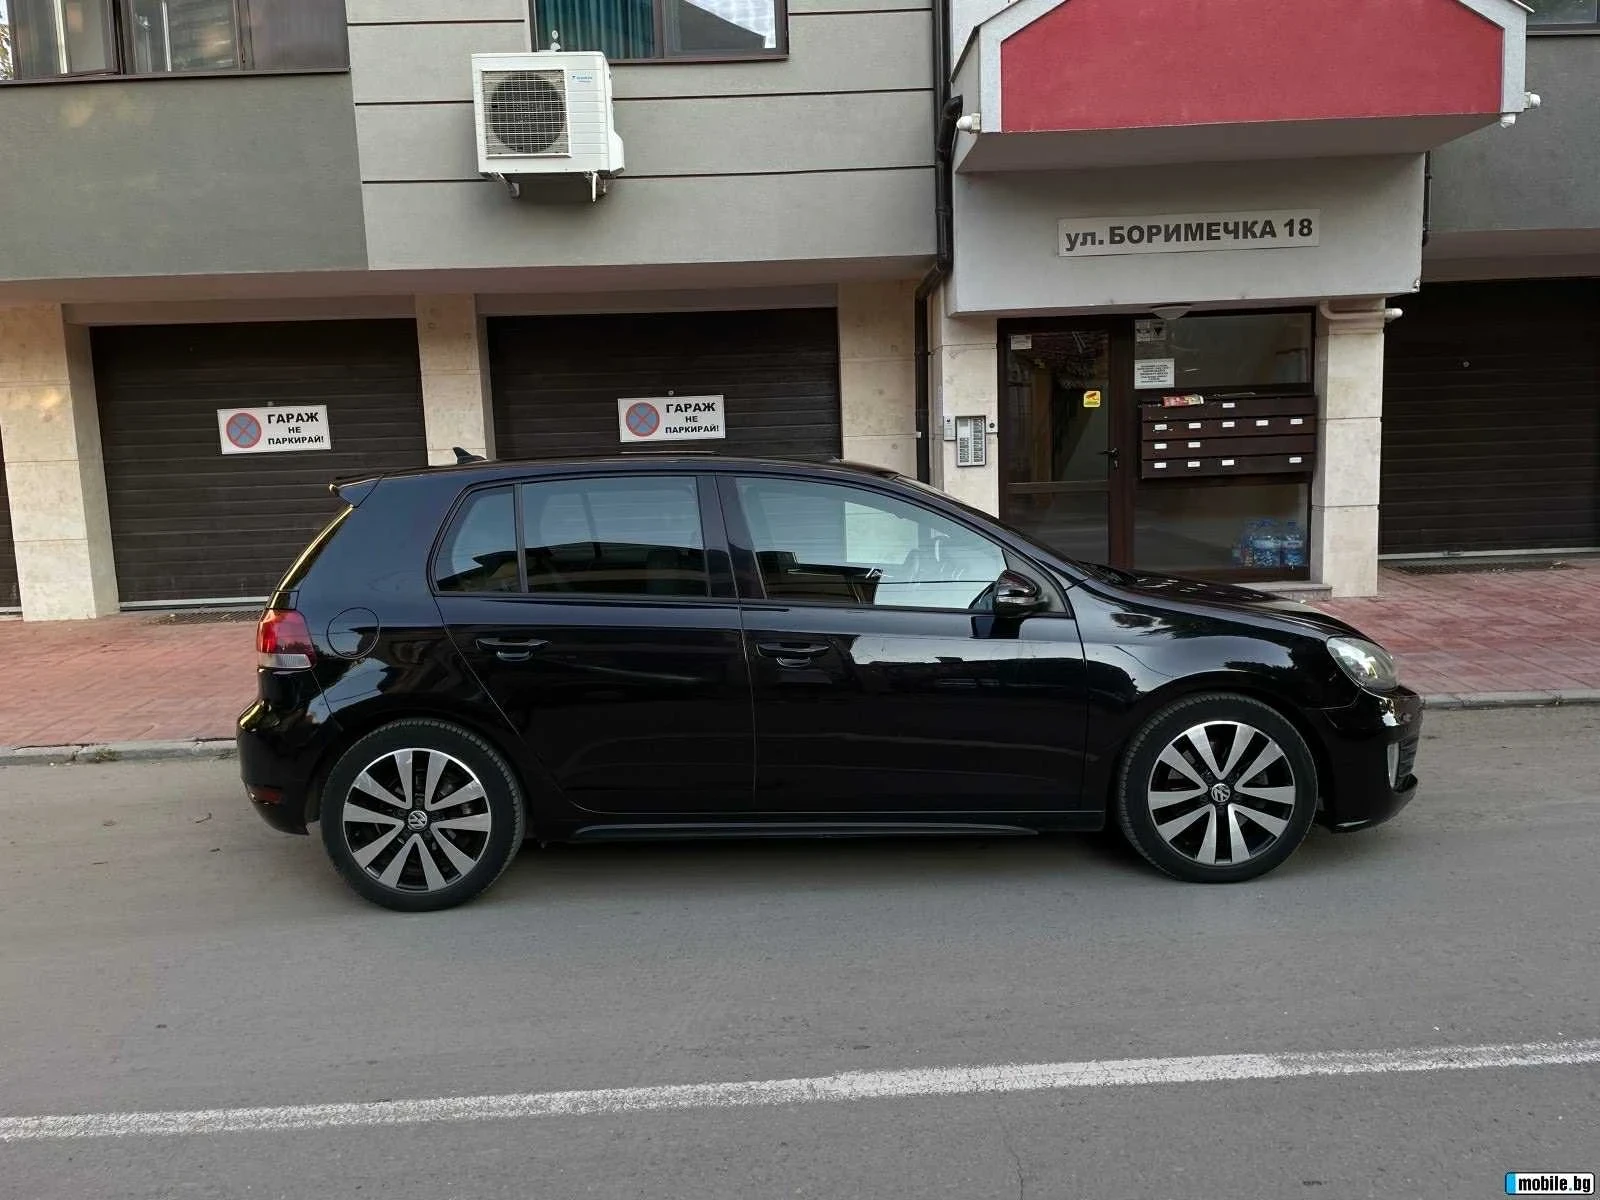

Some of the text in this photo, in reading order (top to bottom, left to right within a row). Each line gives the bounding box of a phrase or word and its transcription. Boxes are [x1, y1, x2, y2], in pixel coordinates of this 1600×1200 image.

[1108, 219, 1277, 245] БОРИМЕЧКА
[1283, 218, 1313, 238] 18
[665, 402, 716, 413] ГАРАЖ
[267, 412, 319, 424] ГАРАЖ
[685, 415, 698, 423] НЕ
[288, 426, 301, 434] НЕ
[665, 424, 719, 434] ПАРКИРАЙ!
[267, 435, 324, 445] ПАРКИРАЙ!
